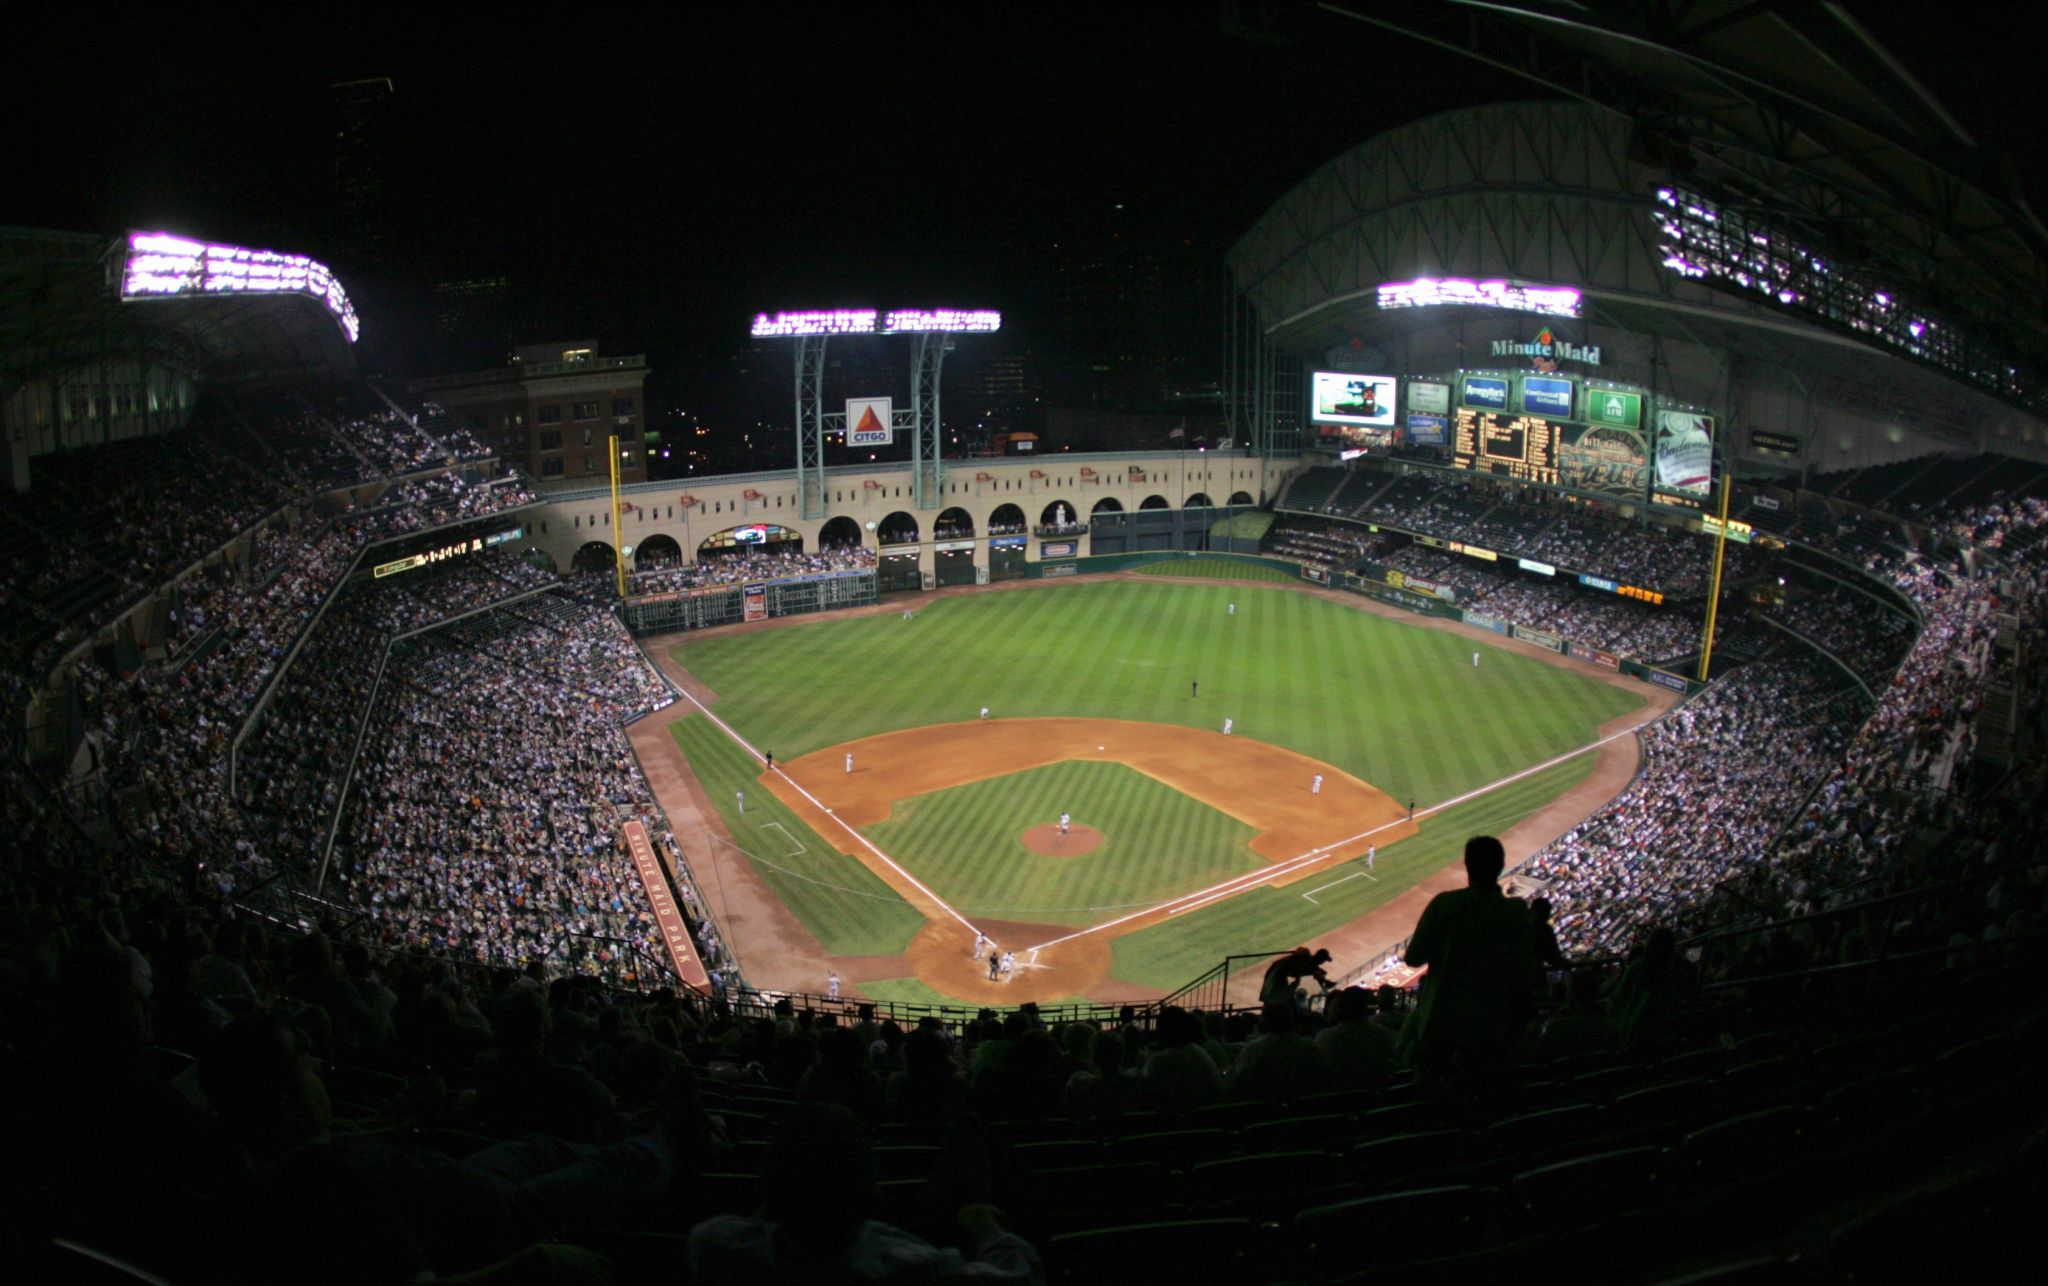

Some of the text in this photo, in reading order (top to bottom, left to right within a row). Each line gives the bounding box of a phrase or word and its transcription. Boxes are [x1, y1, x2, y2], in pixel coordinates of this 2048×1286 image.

[1492, 340, 1600, 365] Minute Maid
[854, 432, 886, 441] CITGO
[631, 834, 691, 963] MINUTE MAID PARK
